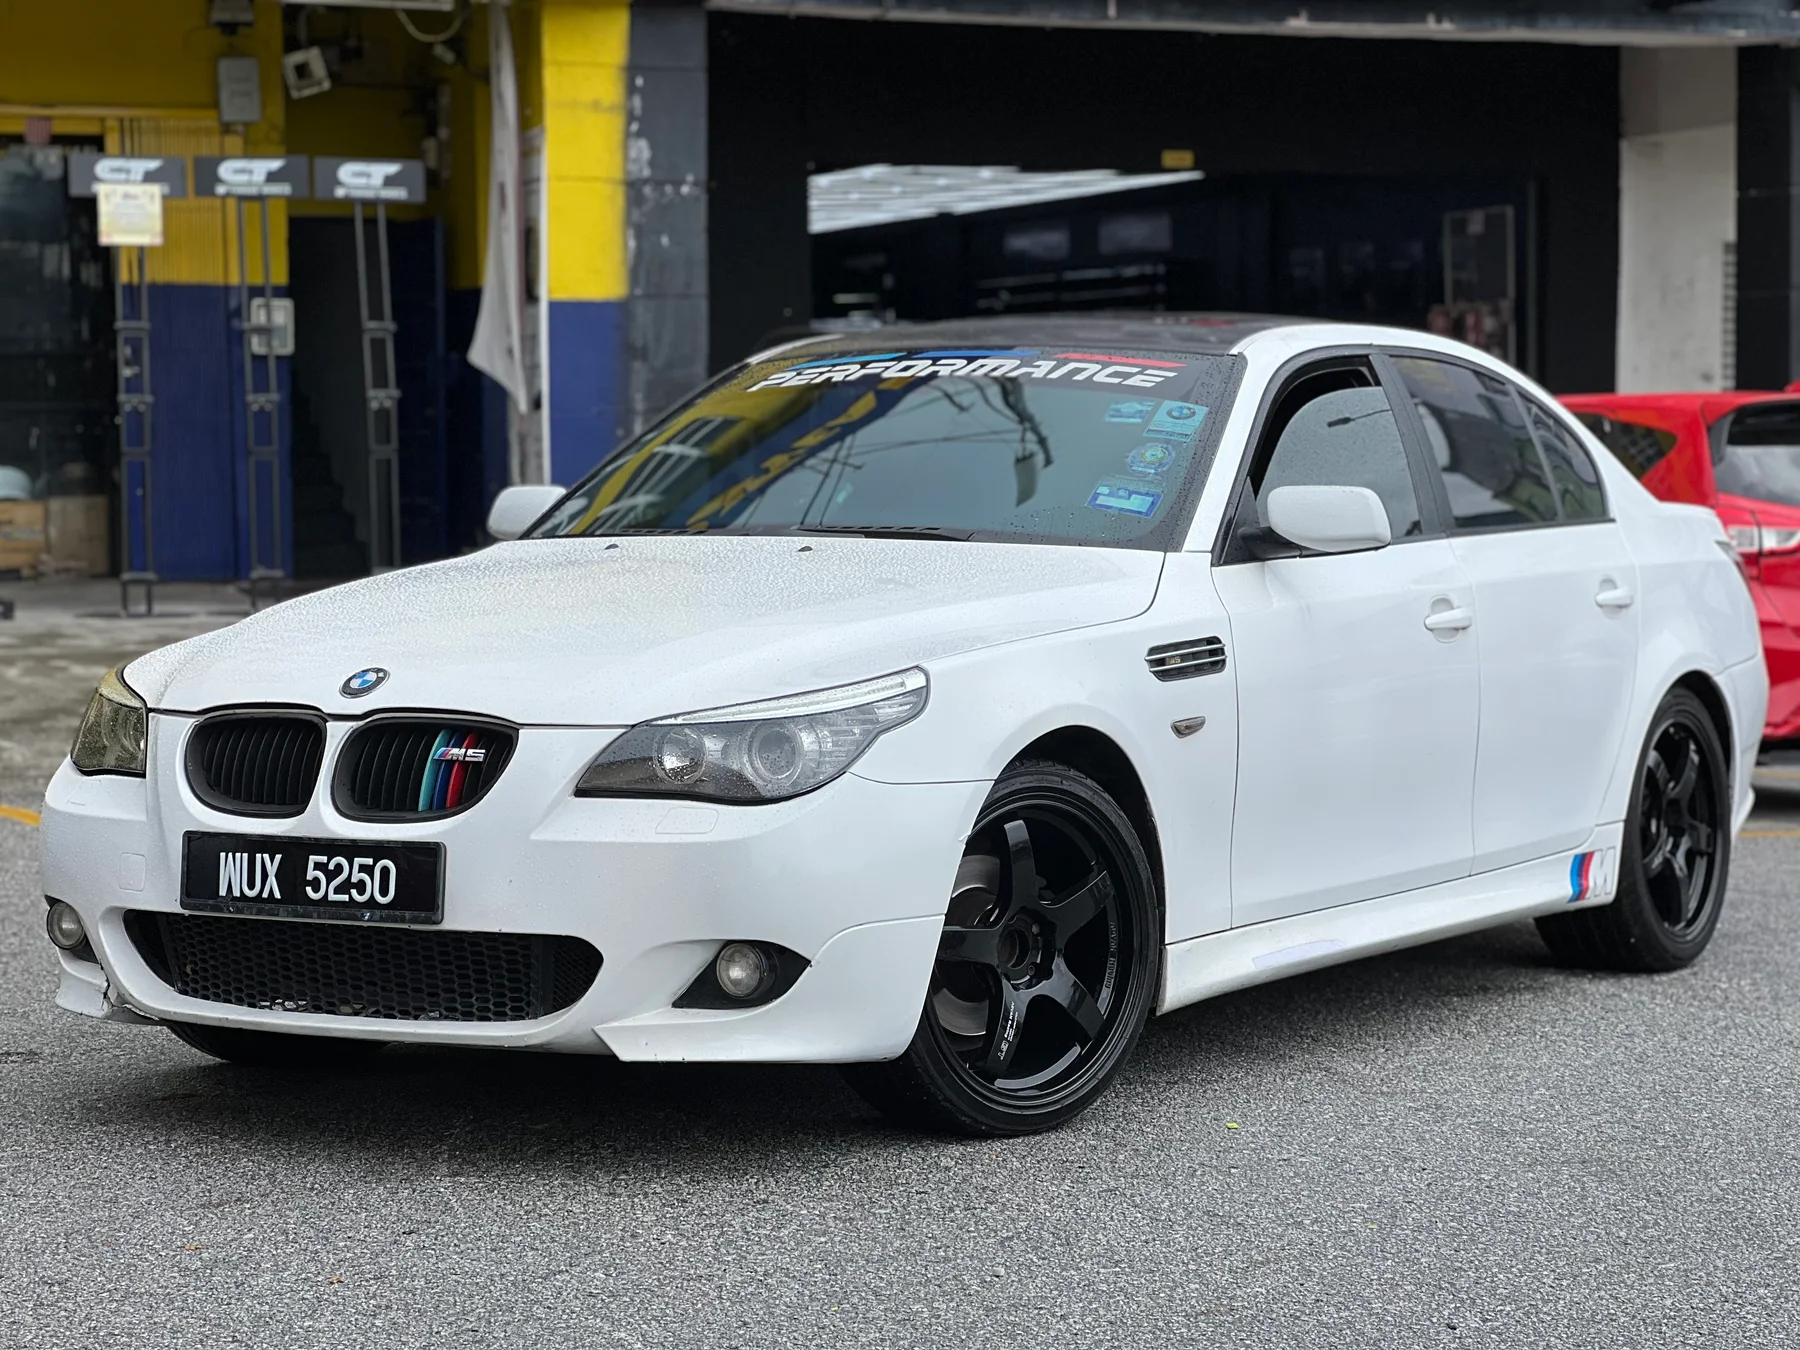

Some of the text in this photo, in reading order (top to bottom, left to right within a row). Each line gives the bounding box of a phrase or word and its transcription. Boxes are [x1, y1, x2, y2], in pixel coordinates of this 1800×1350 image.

[746, 359, 1179, 392] PERFORMANCE
[219, 852, 396, 904] WUX 5250
